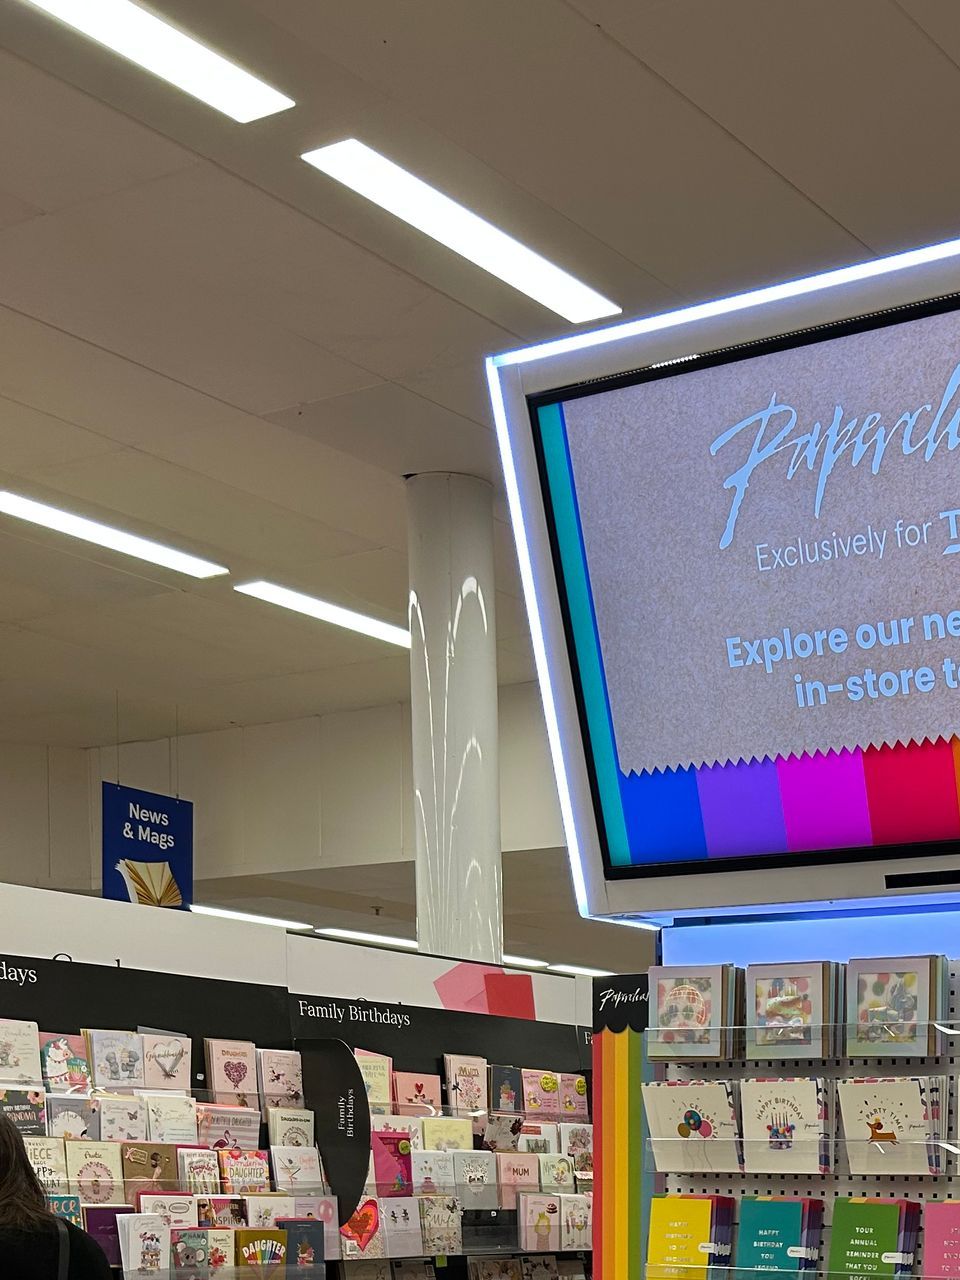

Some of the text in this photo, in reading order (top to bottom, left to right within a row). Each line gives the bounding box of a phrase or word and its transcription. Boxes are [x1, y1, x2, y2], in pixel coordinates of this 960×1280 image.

[756, 520, 890, 572] Exclusively
[894, 518, 934, 550] for
[726, 626, 848, 674] Explore
[857, 620, 915, 652] our
[796, 663, 934, 710] in-store
[128, 802, 169, 827] News
[122, 822, 175, 850] & Mags
[298, 1001, 345, 1022] Family
[349, 1005, 411, 1027] Birthdays
[337, 1095, 346, 1131] Family
[346, 1088, 355, 1137] Birthdays
[757, 1097, 804, 1121] HAPPY BIRTHDAY
[866, 1107, 905, 1133] PARTY TIME!
[229, 1167, 264, 1178] DAUGHTER
[512, 1168, 530, 1176] MUM
[758, 1229, 780, 1237] HAPPY
[855, 1226, 874, 1234] YOUR
[242, 1239, 286, 1258] DAUGHTER
[753, 1241, 784, 1249] BIRTHDAY
[845, 1251, 879, 1259] REMINDER
[850, 1239, 877, 1247] ANNUAL
[845, 1262, 877, 1271] THAT YOU
